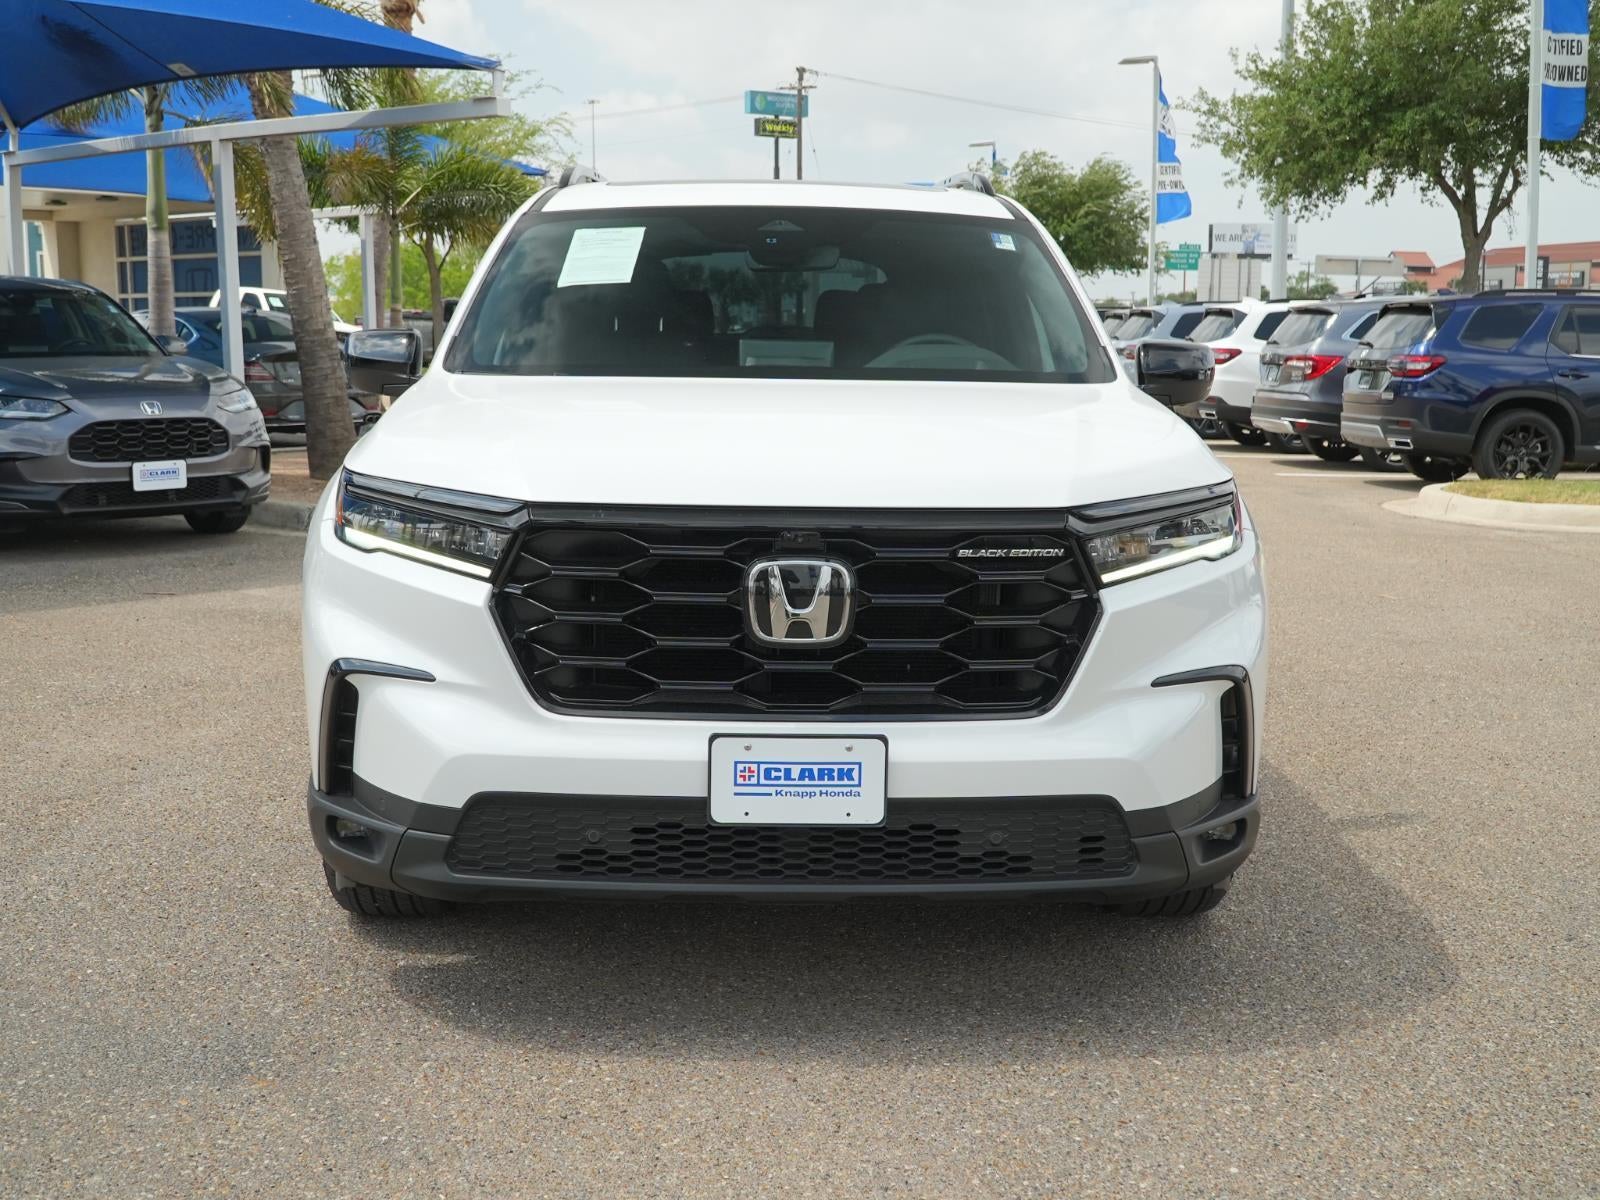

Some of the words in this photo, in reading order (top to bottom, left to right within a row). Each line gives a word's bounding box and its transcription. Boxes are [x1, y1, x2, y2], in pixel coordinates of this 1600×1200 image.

[958, 549, 1007, 557] BLACK
[1009, 548, 1064, 557] EDITION
[763, 767, 855, 782] CLARK
[775, 789, 817, 799] Knapp
[819, 789, 861, 798] Honda
